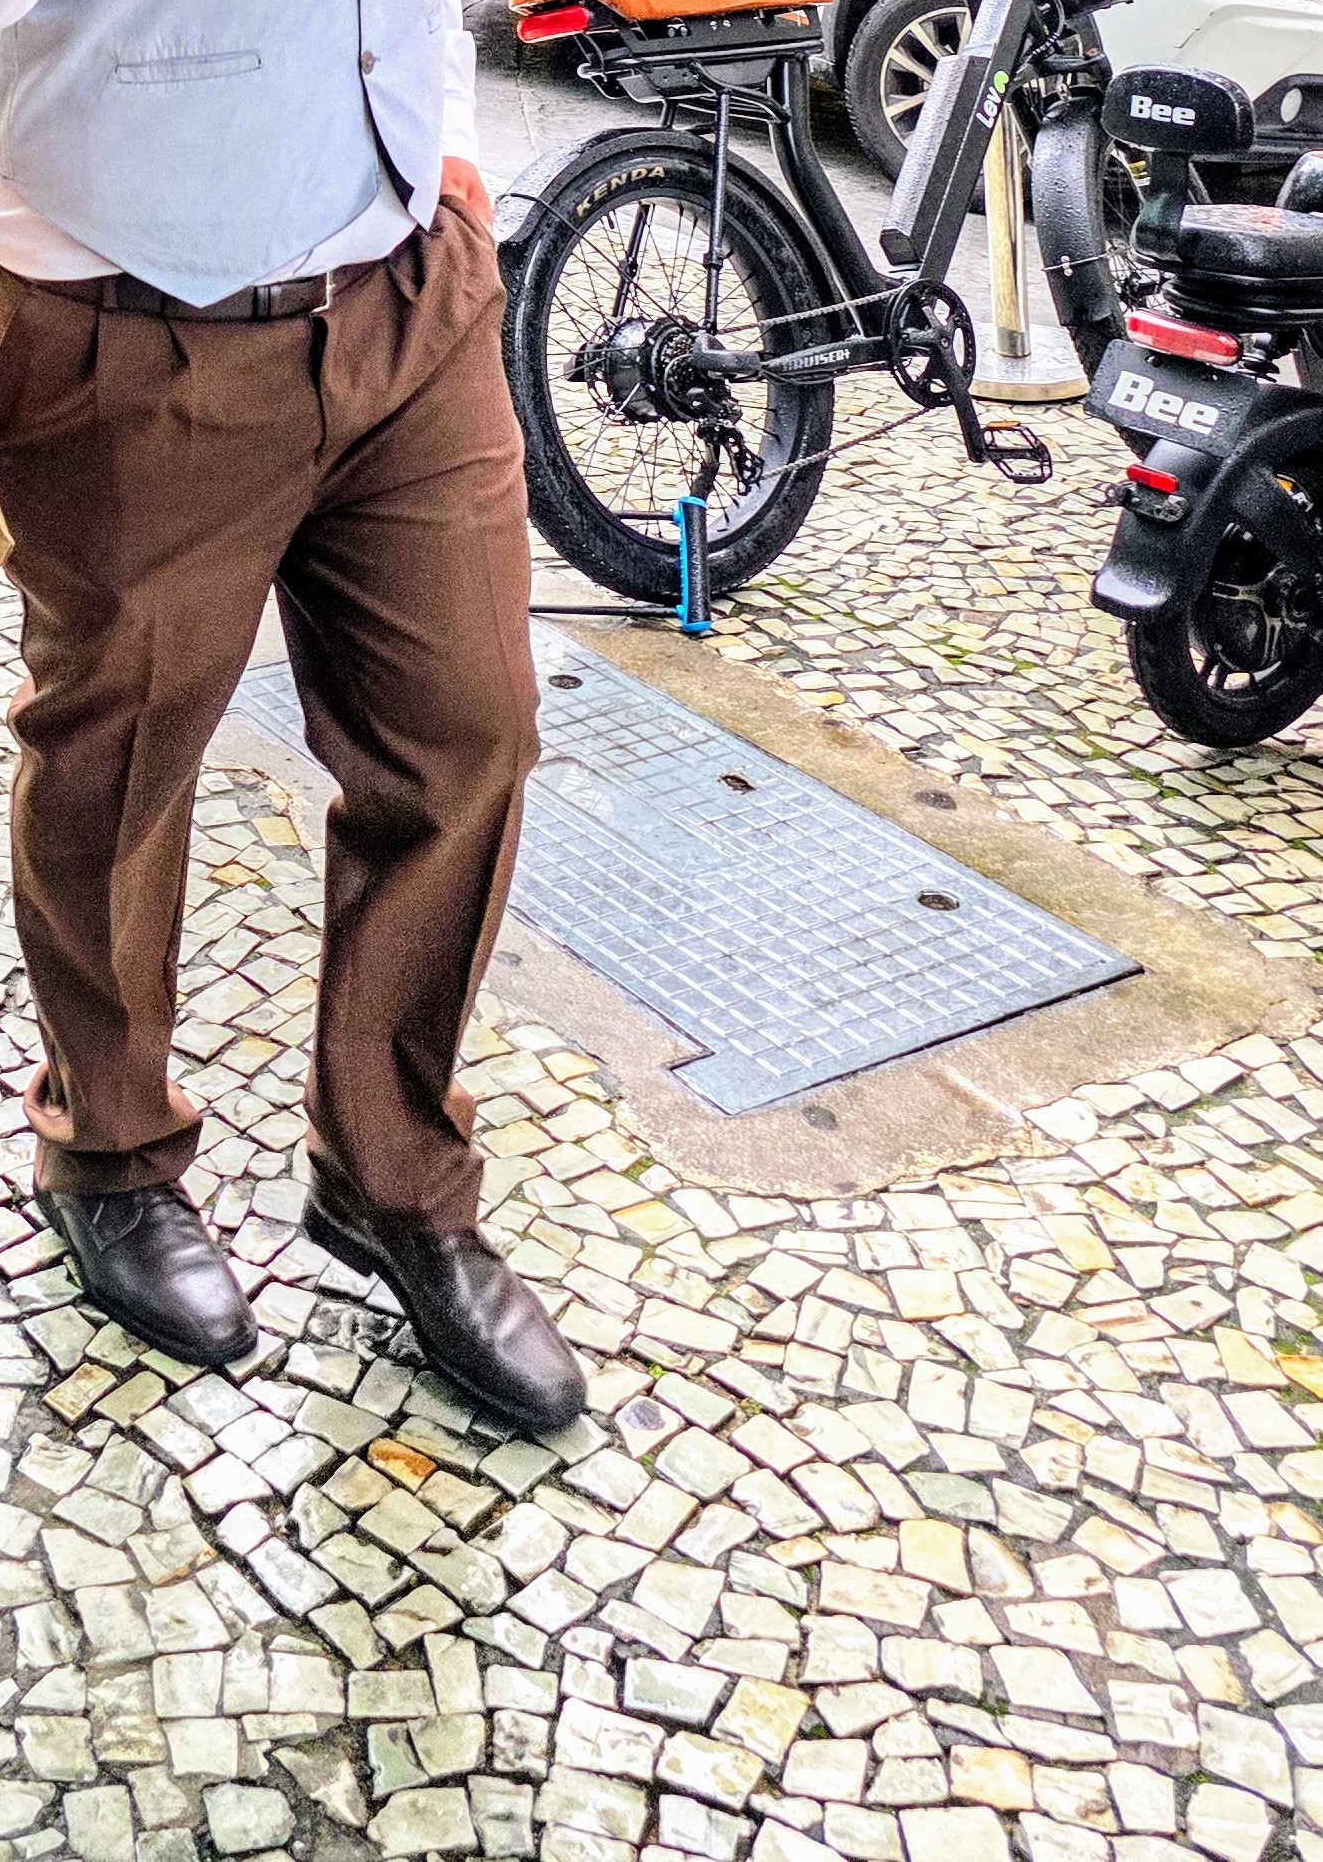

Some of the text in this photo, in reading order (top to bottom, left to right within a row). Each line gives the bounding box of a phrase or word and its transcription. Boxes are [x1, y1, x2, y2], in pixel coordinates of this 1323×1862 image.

[1129, 94, 1196, 126] Bee
[576, 166, 666, 217] KENDA
[1107, 369, 1220, 435] Bee
